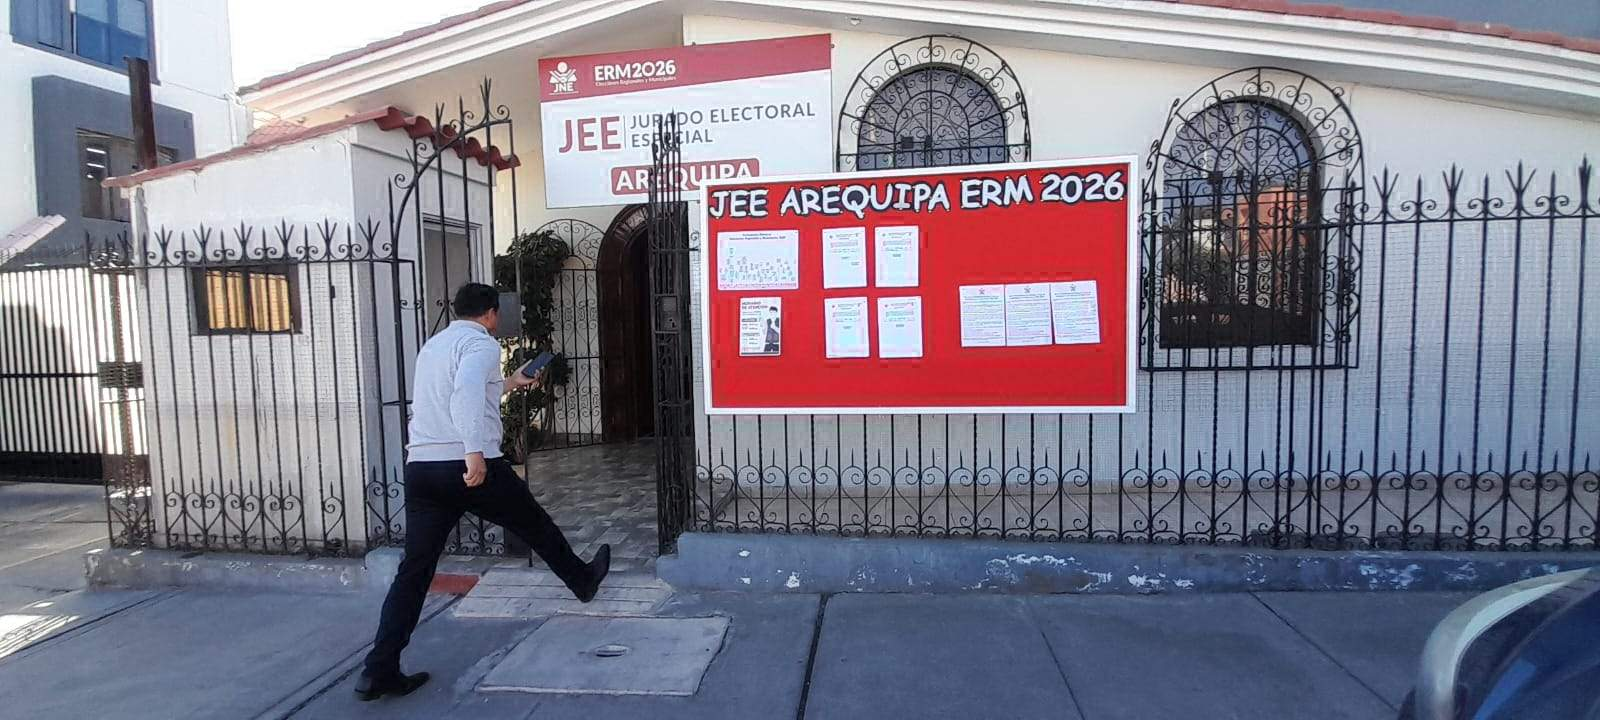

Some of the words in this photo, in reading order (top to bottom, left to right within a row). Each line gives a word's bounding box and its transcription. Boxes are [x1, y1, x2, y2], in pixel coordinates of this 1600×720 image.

[594, 60, 677, 81] ERM2026
[553, 82, 574, 93] JNE
[630, 110, 703, 130] JURADO
[710, 102, 816, 123] ELECTORAL
[559, 116, 622, 153] JEE
[709, 188, 769, 219] JEE
[780, 182, 950, 219] AREQUIPA
[960, 174, 1033, 209] ERM
[1039, 171, 1125, 201] 2026
